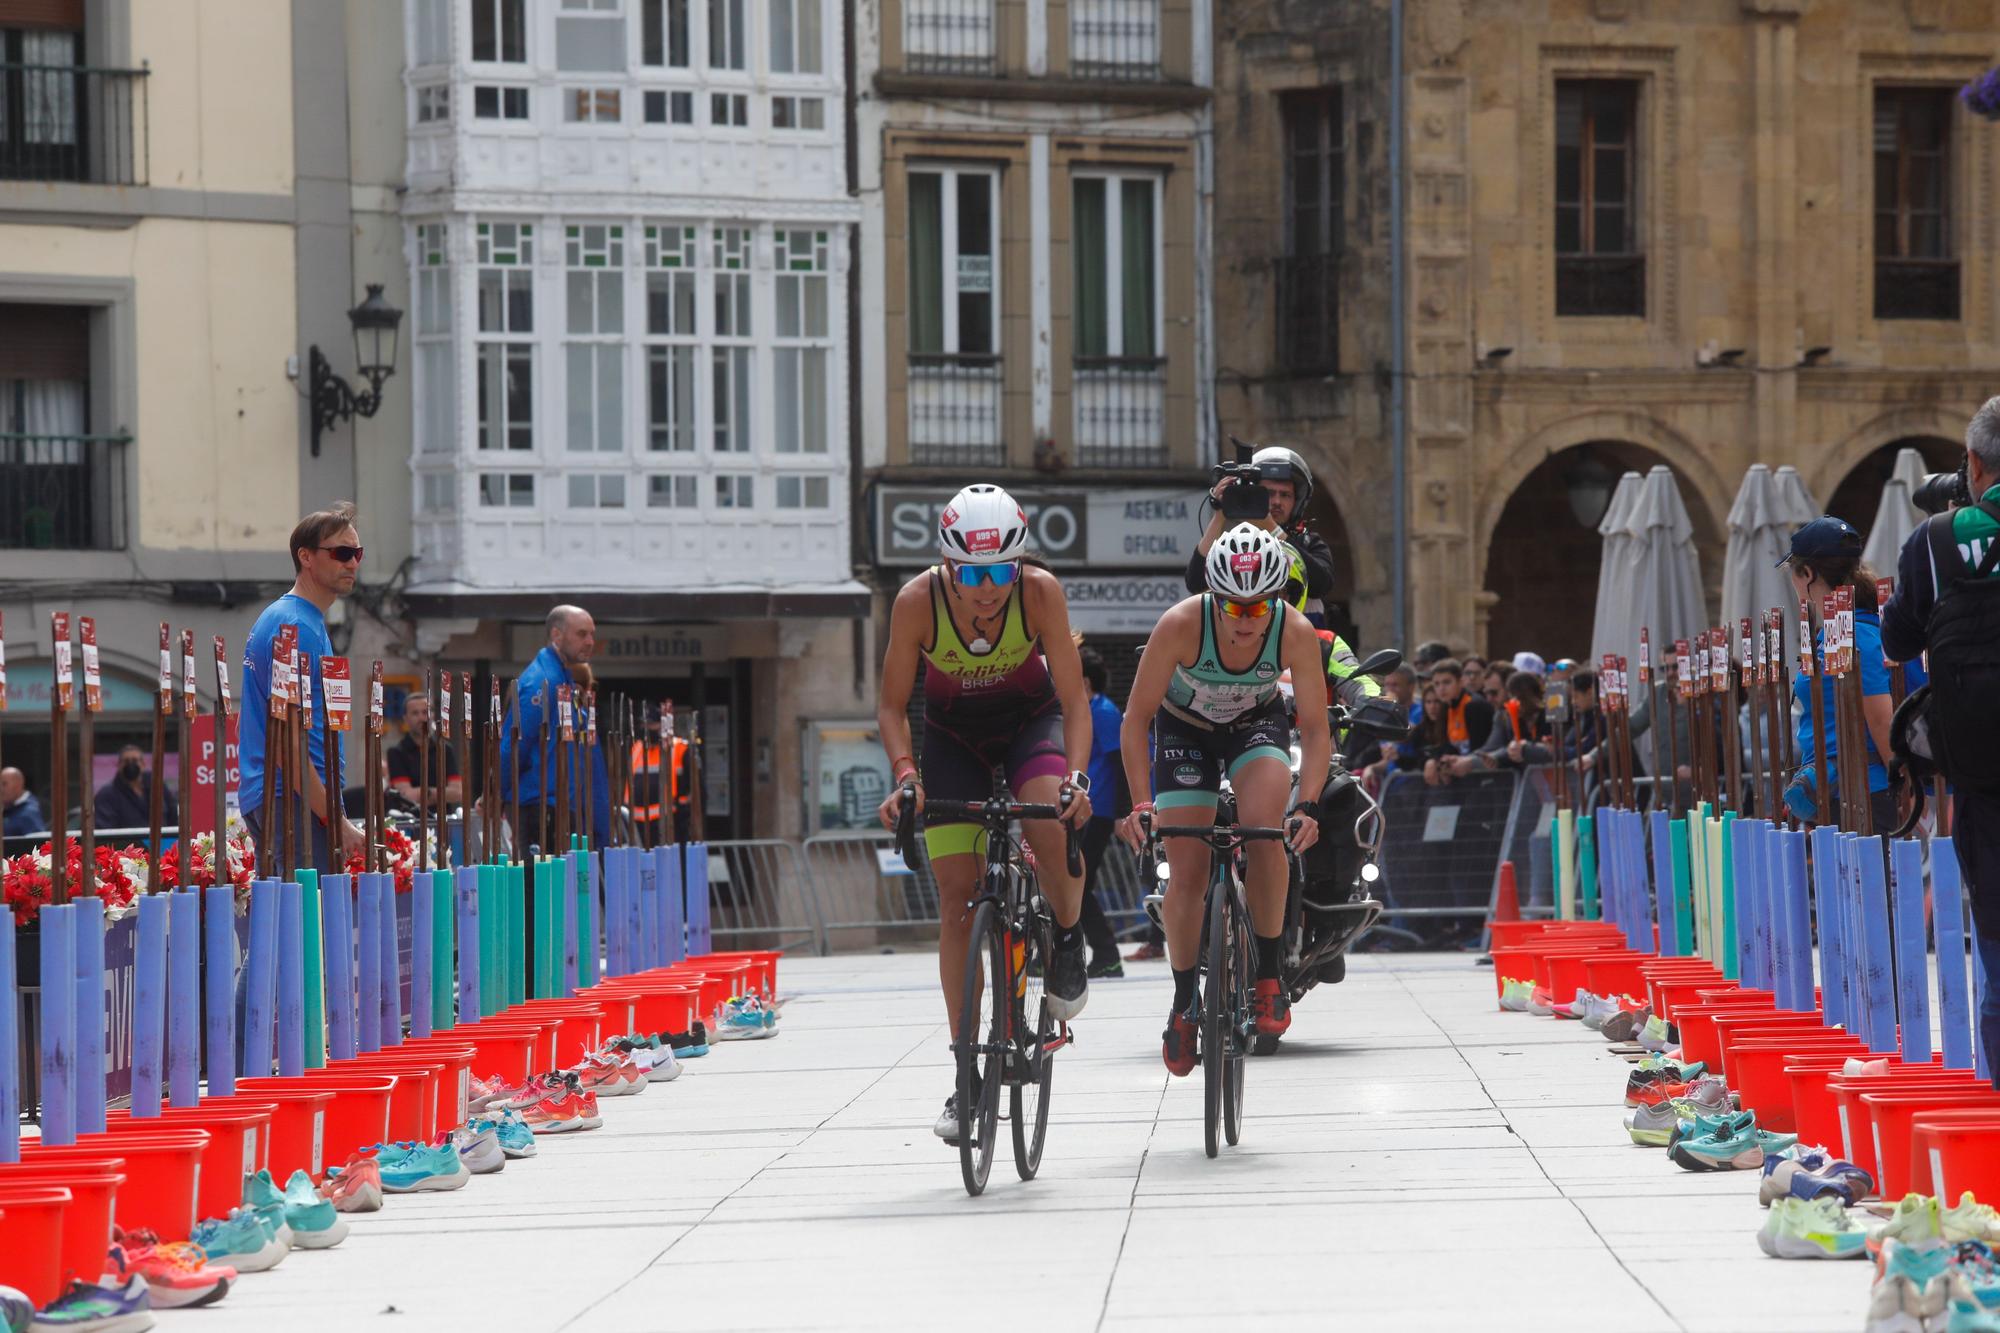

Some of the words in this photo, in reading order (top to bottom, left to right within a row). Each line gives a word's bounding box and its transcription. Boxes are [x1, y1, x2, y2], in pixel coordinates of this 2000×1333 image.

[1124, 500, 1188, 520] AGENCIA
[1124, 535, 1180, 554] OFICIAL
[962, 675, 1006, 690] BREA
[1164, 749, 1185, 760] ITV
